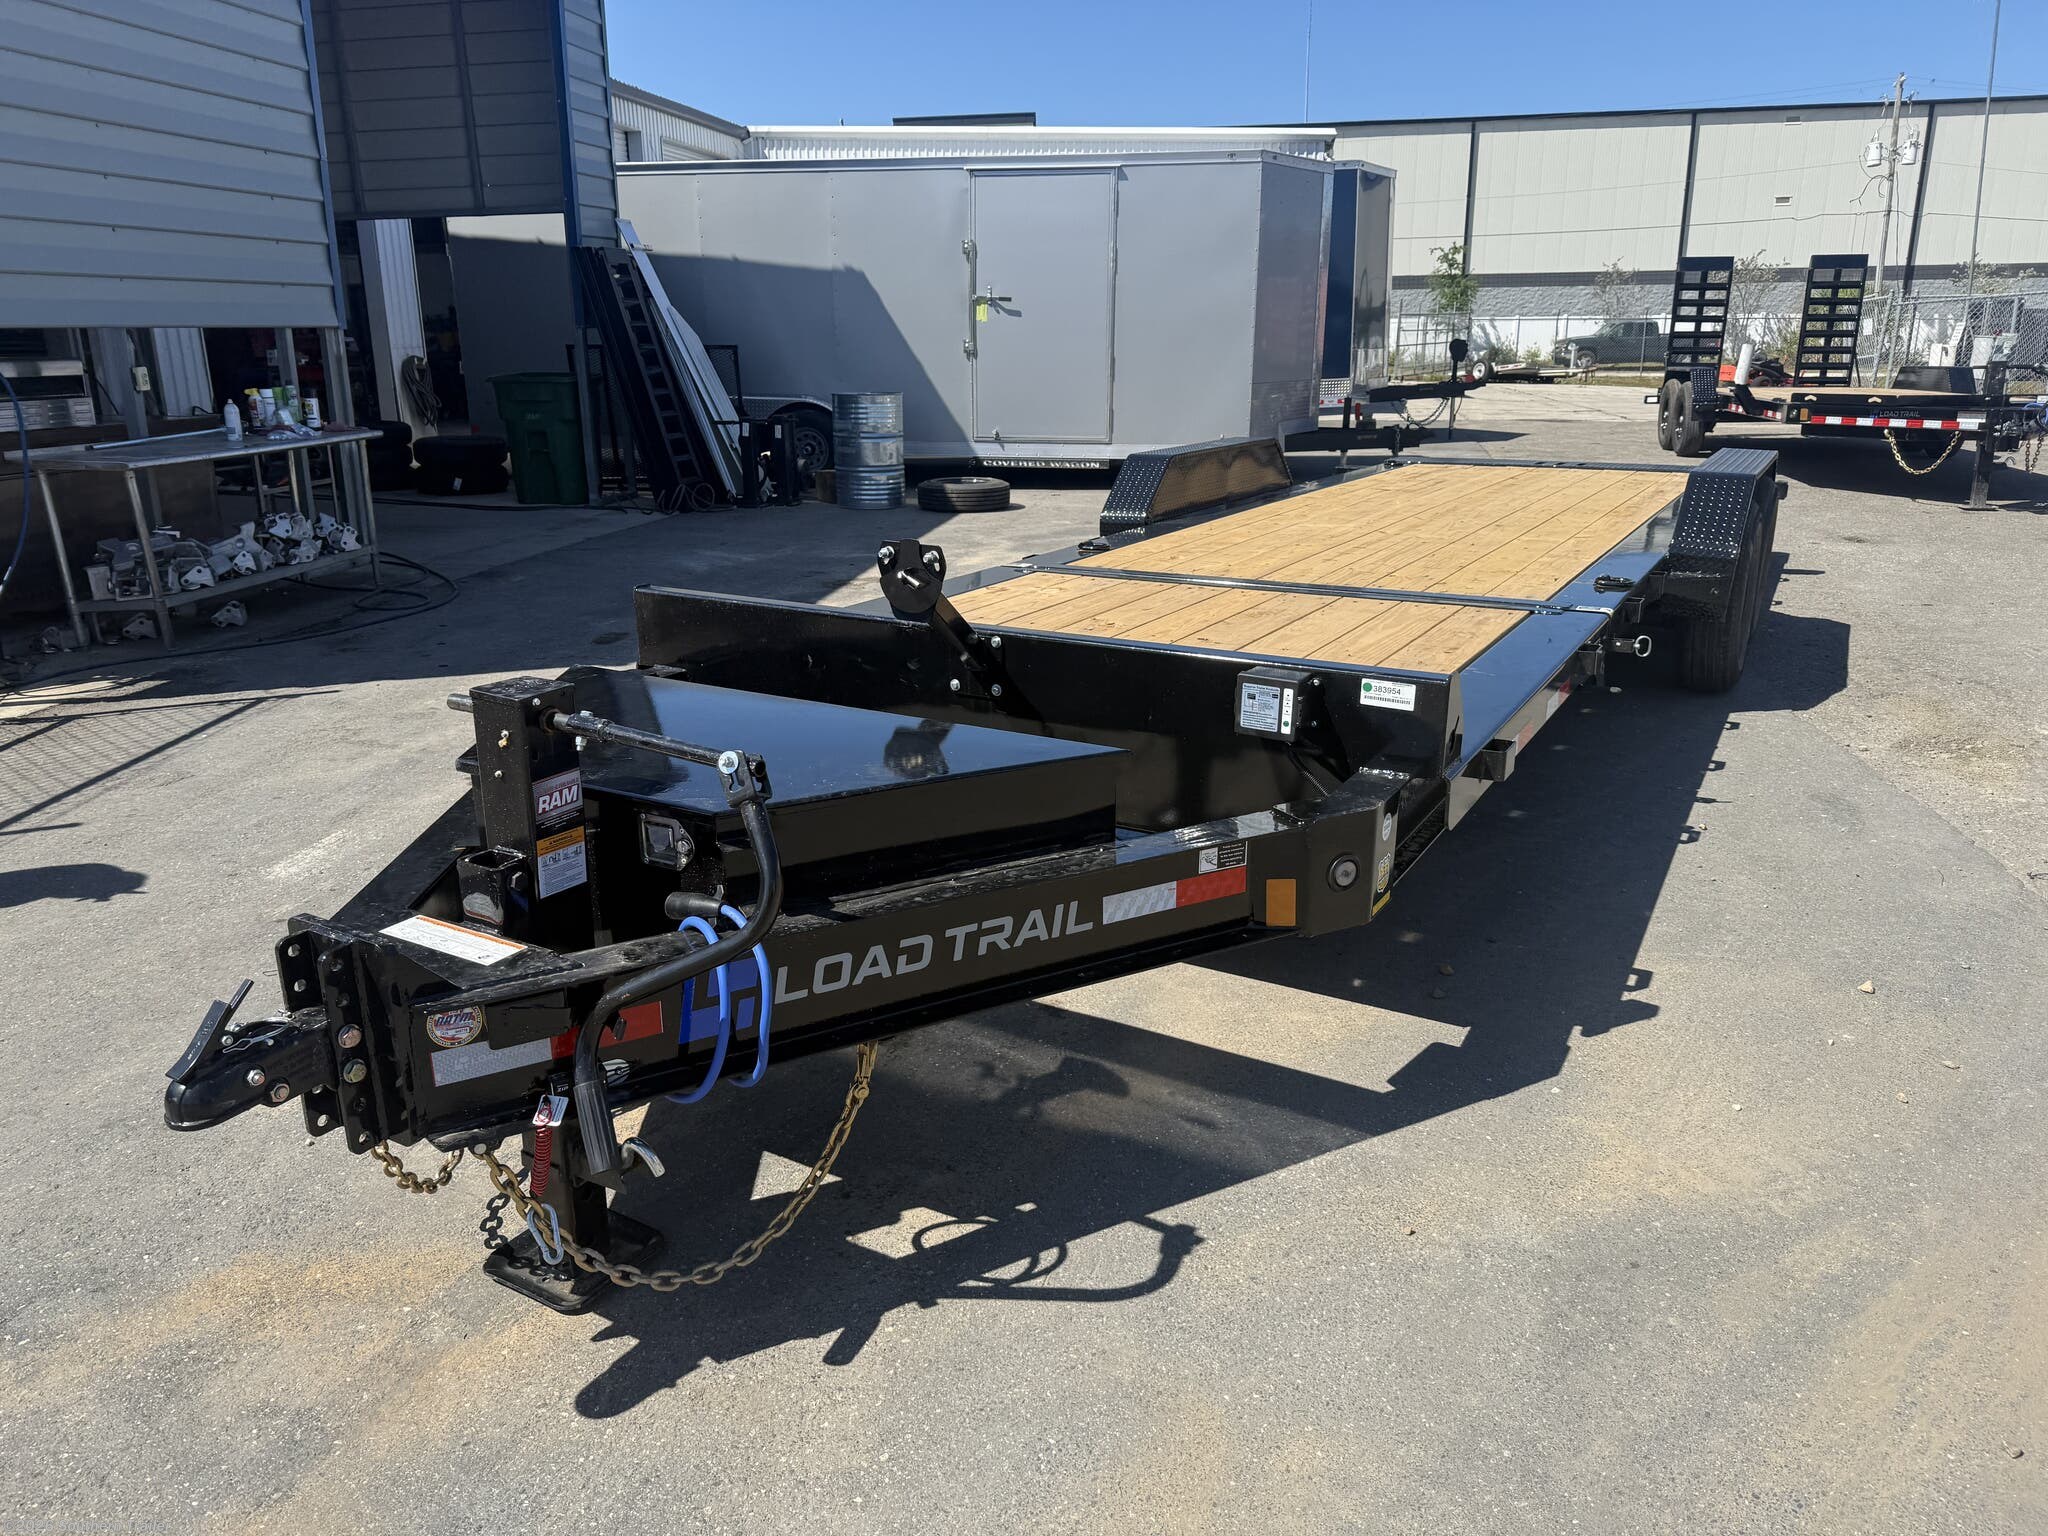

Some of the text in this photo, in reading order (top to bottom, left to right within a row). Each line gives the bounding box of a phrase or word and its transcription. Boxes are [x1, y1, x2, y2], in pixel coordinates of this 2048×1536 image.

[983, 459, 1100, 469] COVERED WAGON
[1373, 685, 1401, 696] 383954
[538, 784, 579, 814] RAM
[774, 901, 1094, 1005] LOAD TRAIL
